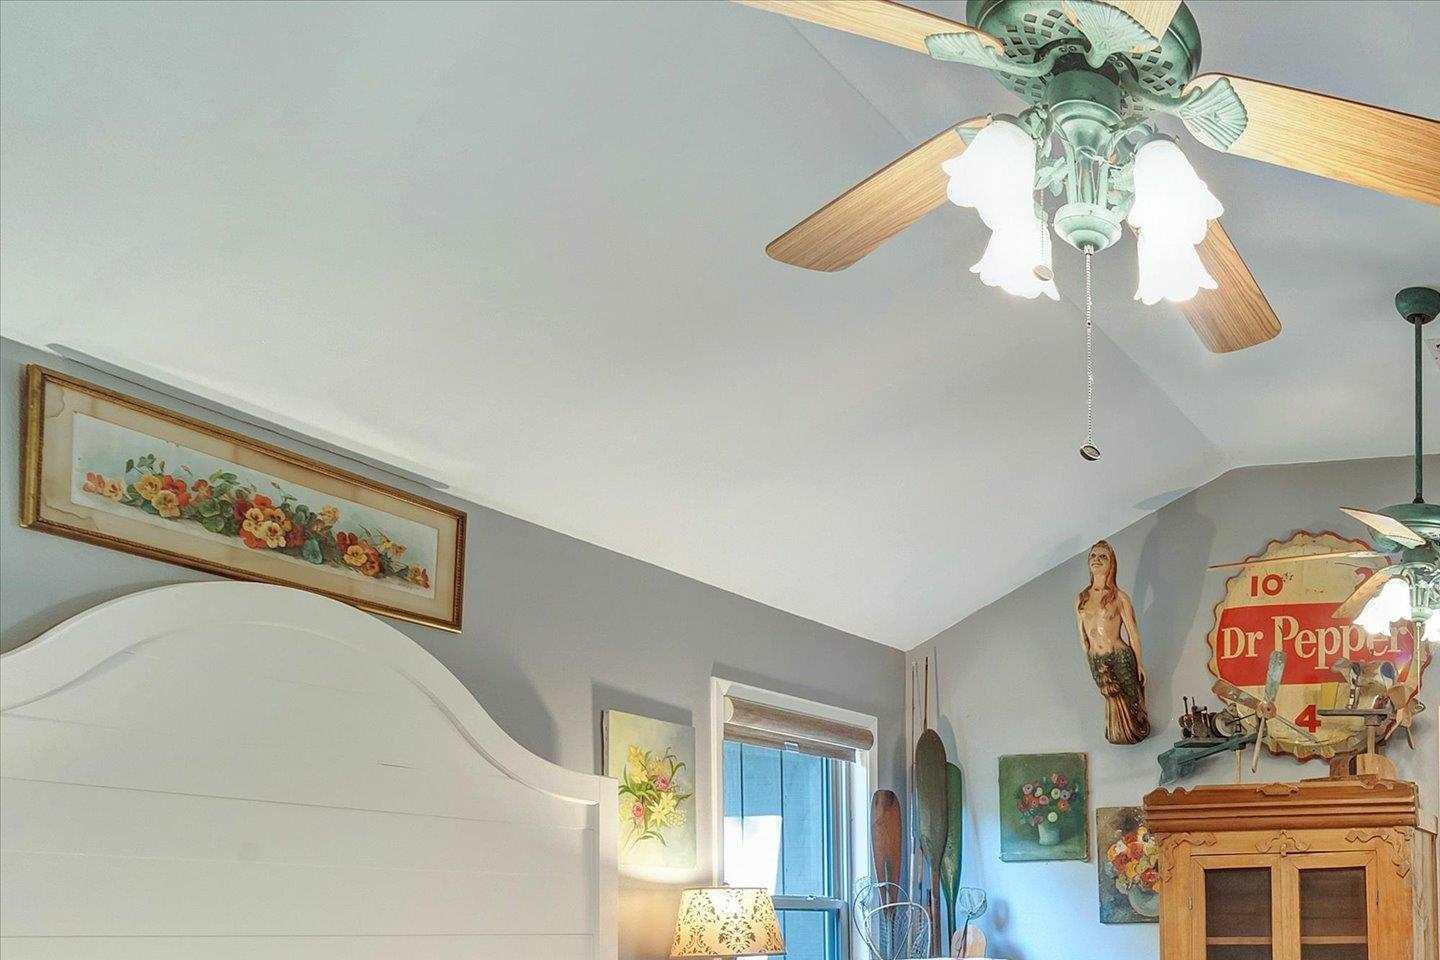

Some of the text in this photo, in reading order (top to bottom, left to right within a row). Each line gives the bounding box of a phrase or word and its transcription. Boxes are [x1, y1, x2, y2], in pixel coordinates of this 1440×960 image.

[1250, 573, 1284, 597] 10
[1220, 627, 1264, 660] Dr
[1294, 704, 1322, 734] 4
